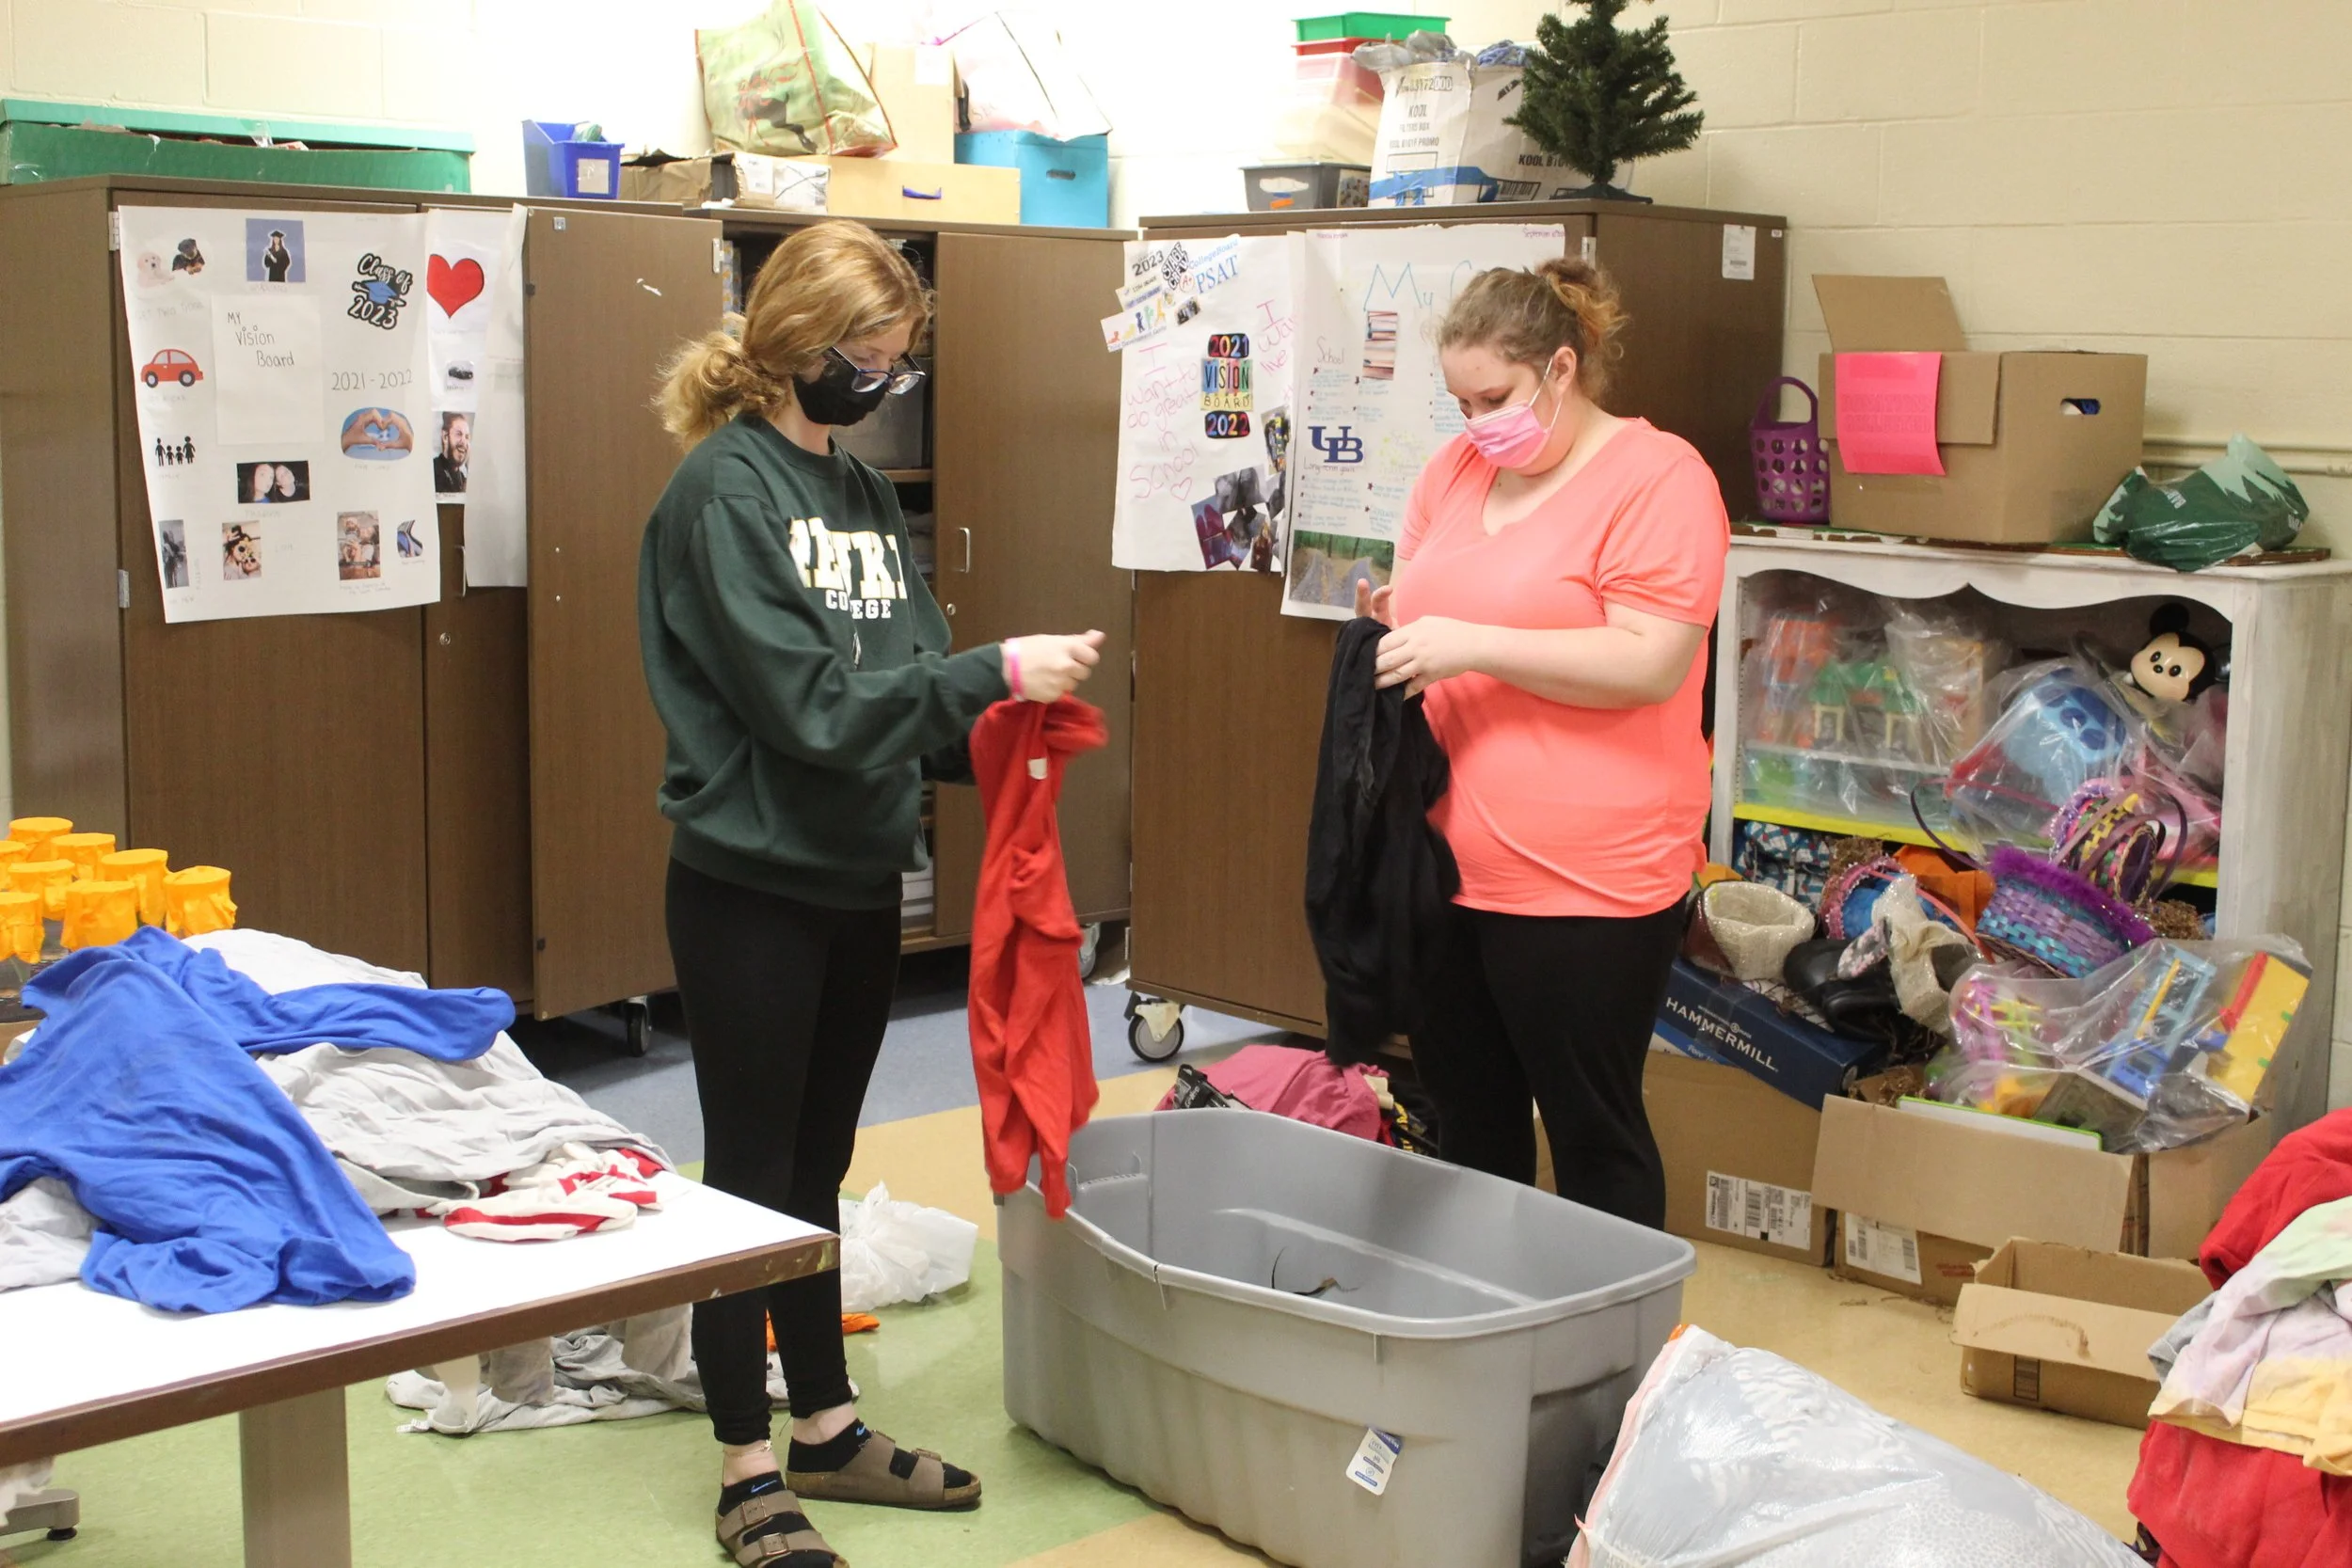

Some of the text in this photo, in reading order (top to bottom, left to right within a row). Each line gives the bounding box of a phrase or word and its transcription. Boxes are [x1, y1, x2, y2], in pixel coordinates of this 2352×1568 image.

[1518, 154, 1544, 166] KOOL
[360, 254, 411, 293] Class of
[1132, 250, 1164, 277] 2023
[1196, 254, 1239, 294] PSAT
[1363, 261, 1434, 315] My
[228, 312, 241, 325] MY
[349, 296, 398, 328] 2023
[235, 325, 276, 346] Vision
[1210, 334, 1249, 357] 2021
[256, 350, 295, 368] Board
[1317, 336, 1345, 365] School
[1204, 362, 1250, 390] VISION
[1154, 389, 1200, 432] great
[1203, 394, 1250, 407] BOARD
[1206, 413, 1250, 436] 2022
[1159, 431, 1177, 452] in
[1308, 426, 1364, 463] UB
[825, 589, 892, 620] COEGE
[1665, 996, 1776, 1072] HAMMERMILL
